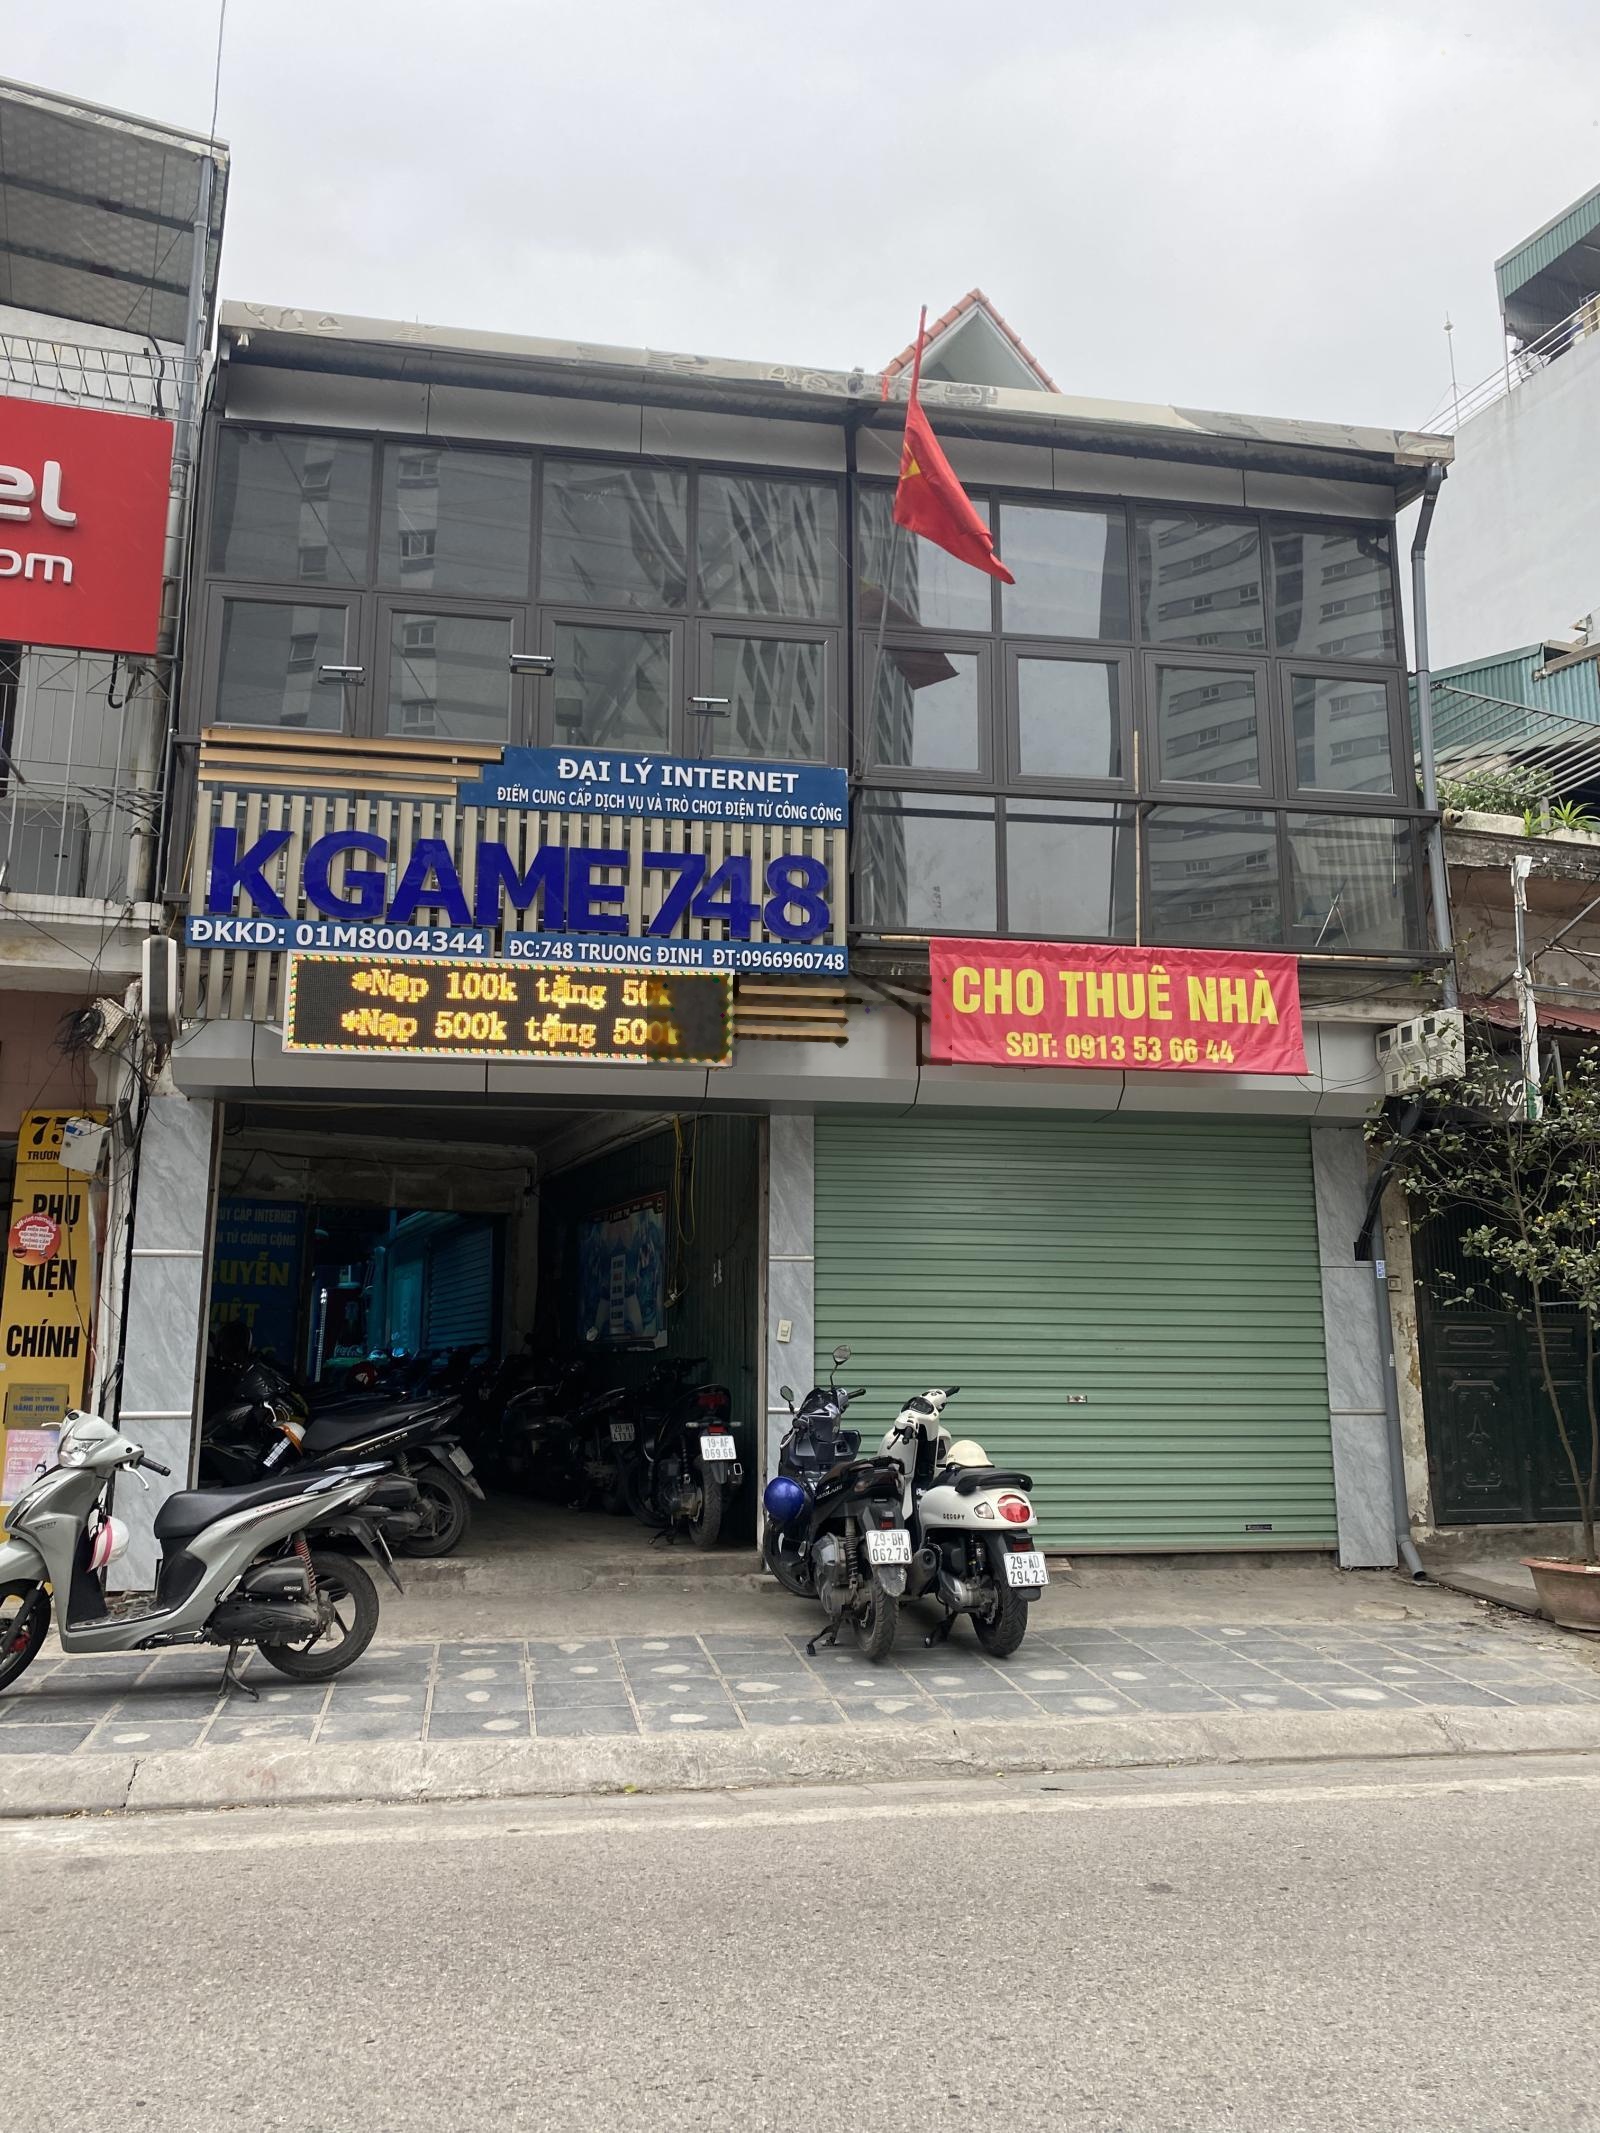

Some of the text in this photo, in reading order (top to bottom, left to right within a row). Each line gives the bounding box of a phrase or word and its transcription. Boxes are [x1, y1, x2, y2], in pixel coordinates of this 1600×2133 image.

[558, 757, 799, 793] ĐẠI LÝ INTERNET
[497, 784, 842, 824] ĐIỂM CUNG CẤP DỊCH VỤ VÀ TRÒ CHƠI ĐIỆN TỬ CÔNG CỘNG
[191, 919, 484, 954] ĐKKD: 01M8004344
[509, 940, 845, 970] ĐC:748 TRUONG ĐINH ĐT:0966960748
[445, 971, 517, 1001] 100k
[536, 974, 606, 1009] tặng
[953, 964, 1279, 1024] CHO THUÊ NHÀ
[435, 1012, 507, 1043] 500k
[525, 1014, 596, 1047] tặng
[1006, 1031, 1235, 1064] SĐT: 0913 53 66 44
[27, 1150, 60, 1161] TRƯƠN
[32, 1193, 81, 1233] PHỤ
[22, 1253, 77, 1297] KIỆN
[213, 1251, 289, 1287] UYỄN
[6, 1319, 80, 1357] CHÍNH
[872, 1548, 909, 1561] 062.78
[1010, 1570, 1046, 1584] 294.23
